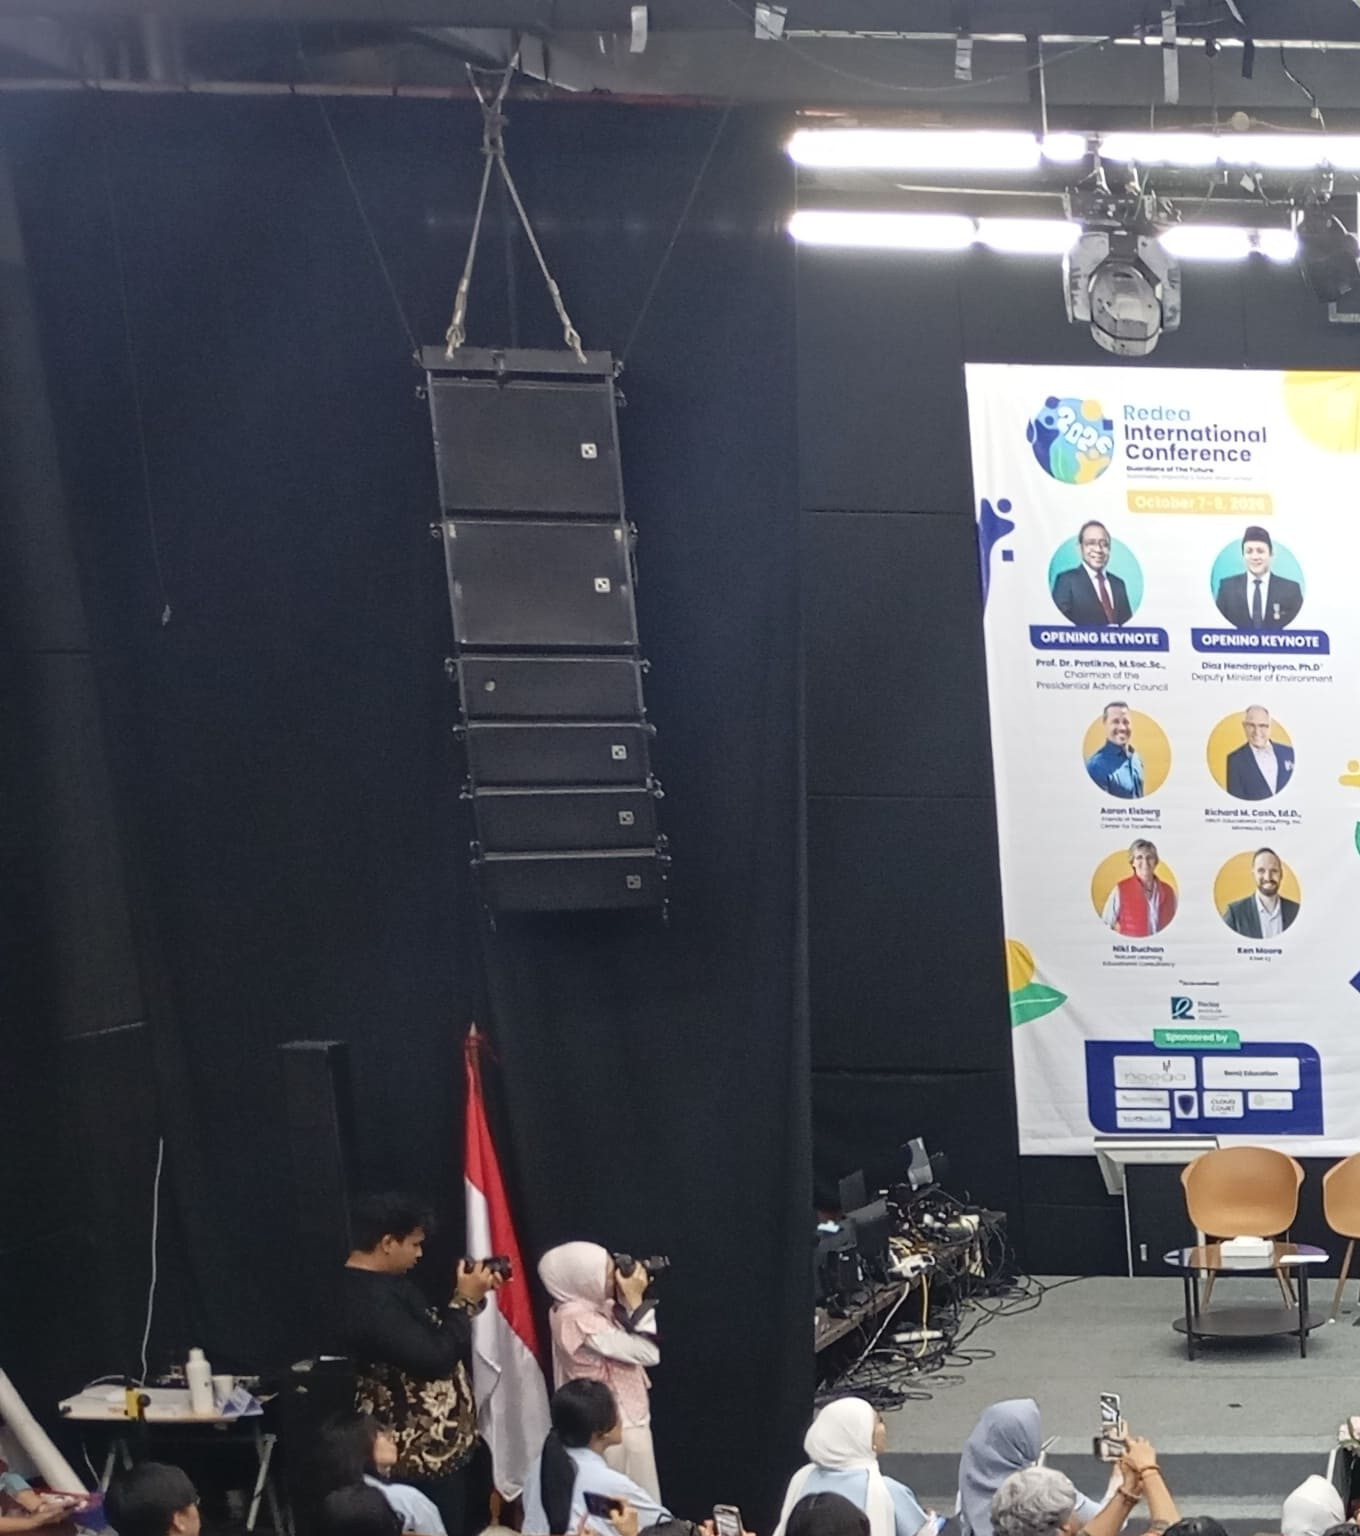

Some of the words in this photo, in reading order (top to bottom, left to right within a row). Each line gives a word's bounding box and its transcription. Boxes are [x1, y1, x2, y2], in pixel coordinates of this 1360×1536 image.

[1123, 404, 1191, 421] Redea
[1124, 424, 1267, 443] International
[1125, 443, 1252, 462] Conference
[1040, 632, 1099, 644] OPENING
[1100, 633, 1160, 645] KEYNOTE
[1201, 634, 1259, 646] OPENING
[1261, 635, 1320, 647] KEYNOTE
[1036, 659, 1056, 667] Prof.
[1059, 659, 1071, 667] Dr.
[1201, 661, 1222, 670] Diaz
[1064, 670, 1111, 679] Chairman
[1113, 671, 1122, 679] of
[1124, 671, 1140, 680] the
[1191, 672, 1224, 682] Deputy
[1226, 673, 1262, 681] Minister
[1264, 673, 1273, 681] of
[1275, 674, 1333, 682] Environment
[1036, 681, 1090, 689] Presidential
[1093, 682, 1131, 692] Advisory
[1133, 682, 1168, 691] Council
[1204, 808, 1239, 816] Richard
[1165, 1033, 1214, 1044] Sponsored
[1215, 1033, 1228, 1044] by
